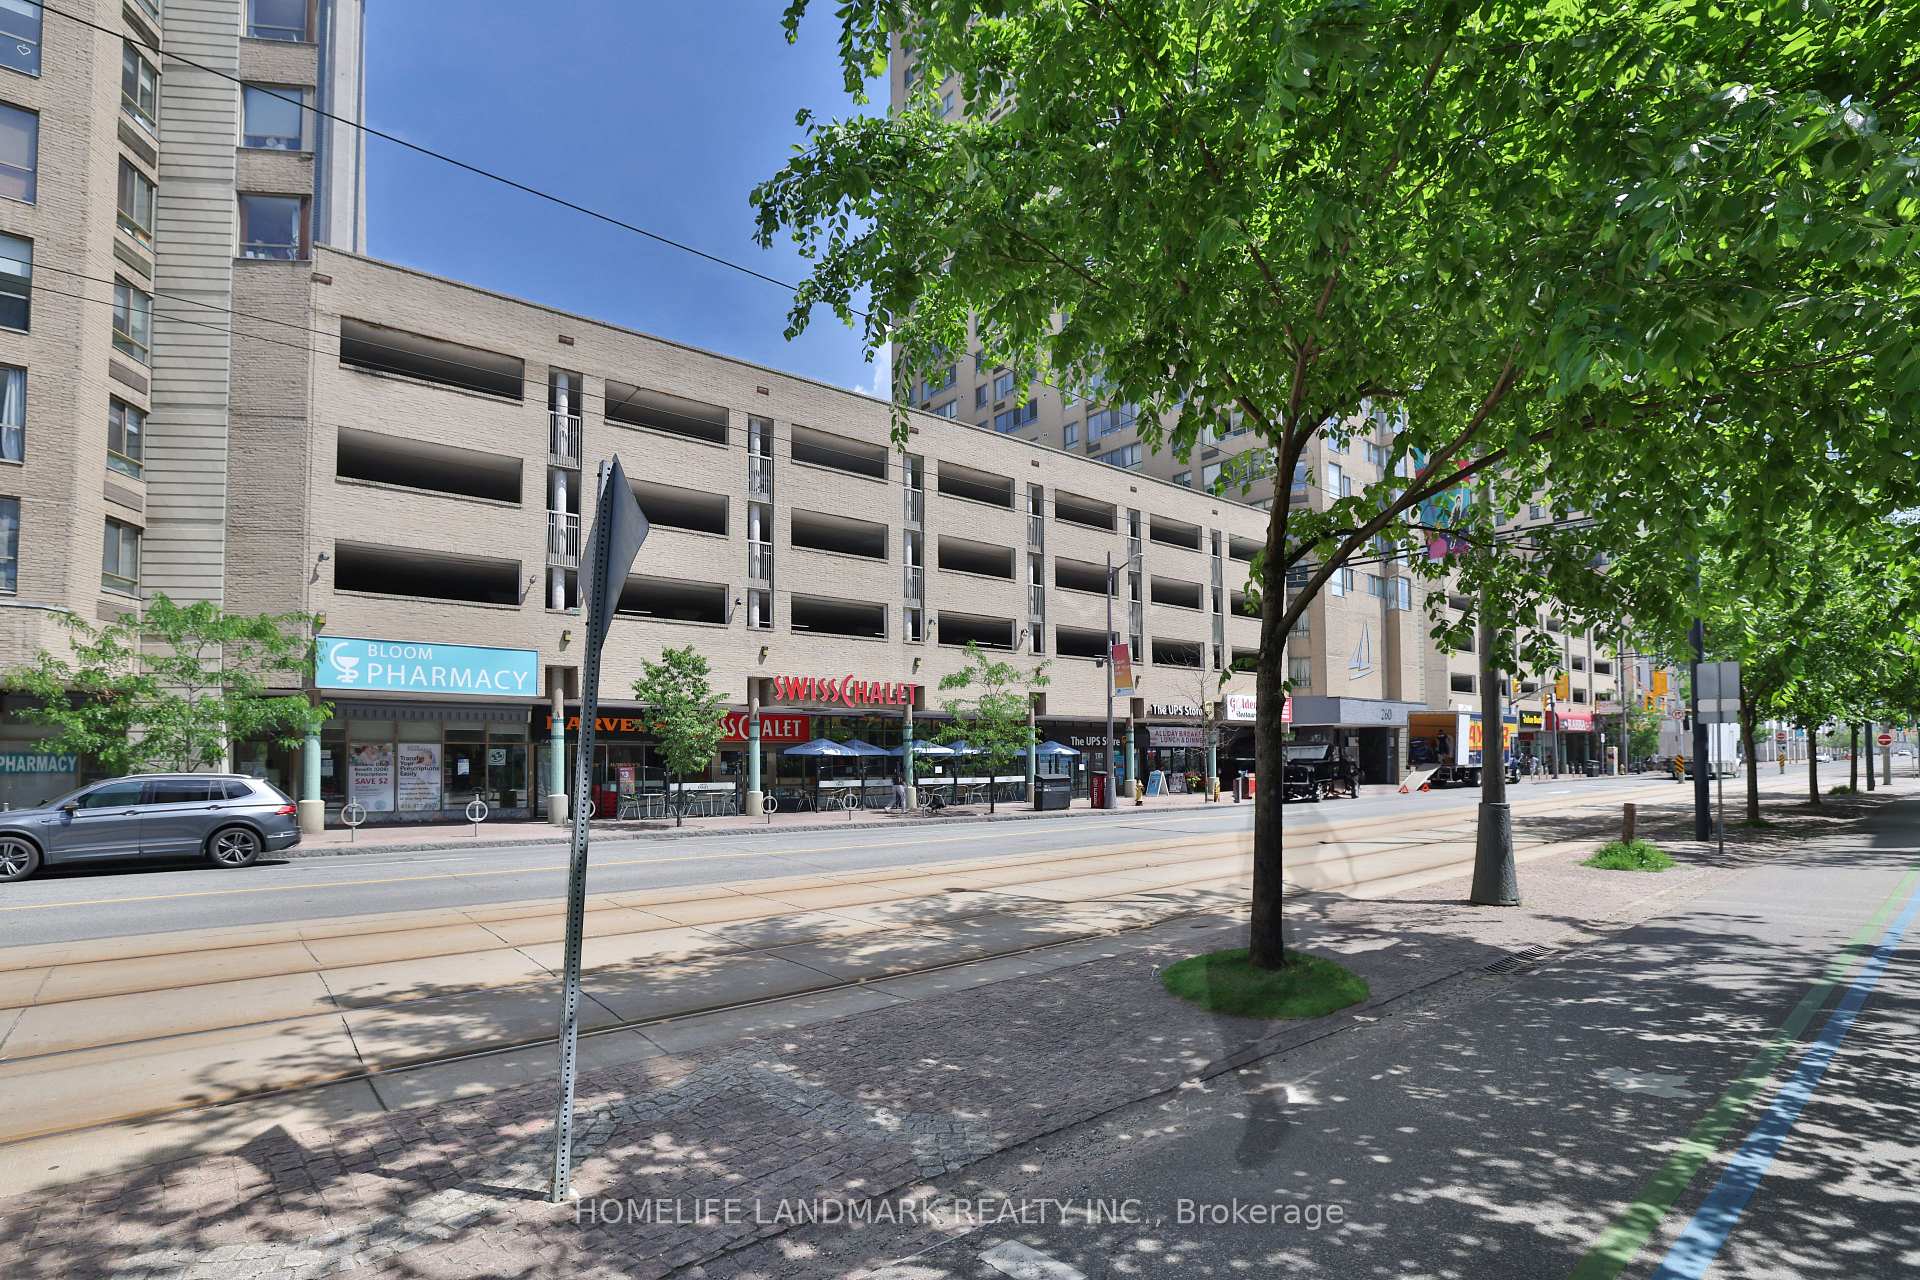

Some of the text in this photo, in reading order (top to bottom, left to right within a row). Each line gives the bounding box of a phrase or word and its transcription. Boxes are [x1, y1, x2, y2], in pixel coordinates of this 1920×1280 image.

[368, 644, 433, 660] BLOOM
[367, 662, 529, 690] PHARMACY
[1151, 704, 1167, 715] The
[1168, 705, 1183, 716] UPS
[1381, 708, 1393, 721] 260
[1070, 736, 1085, 746] The
[1086, 736, 1101, 746] UPS
[354, 777, 389, 785] SAVE $2
